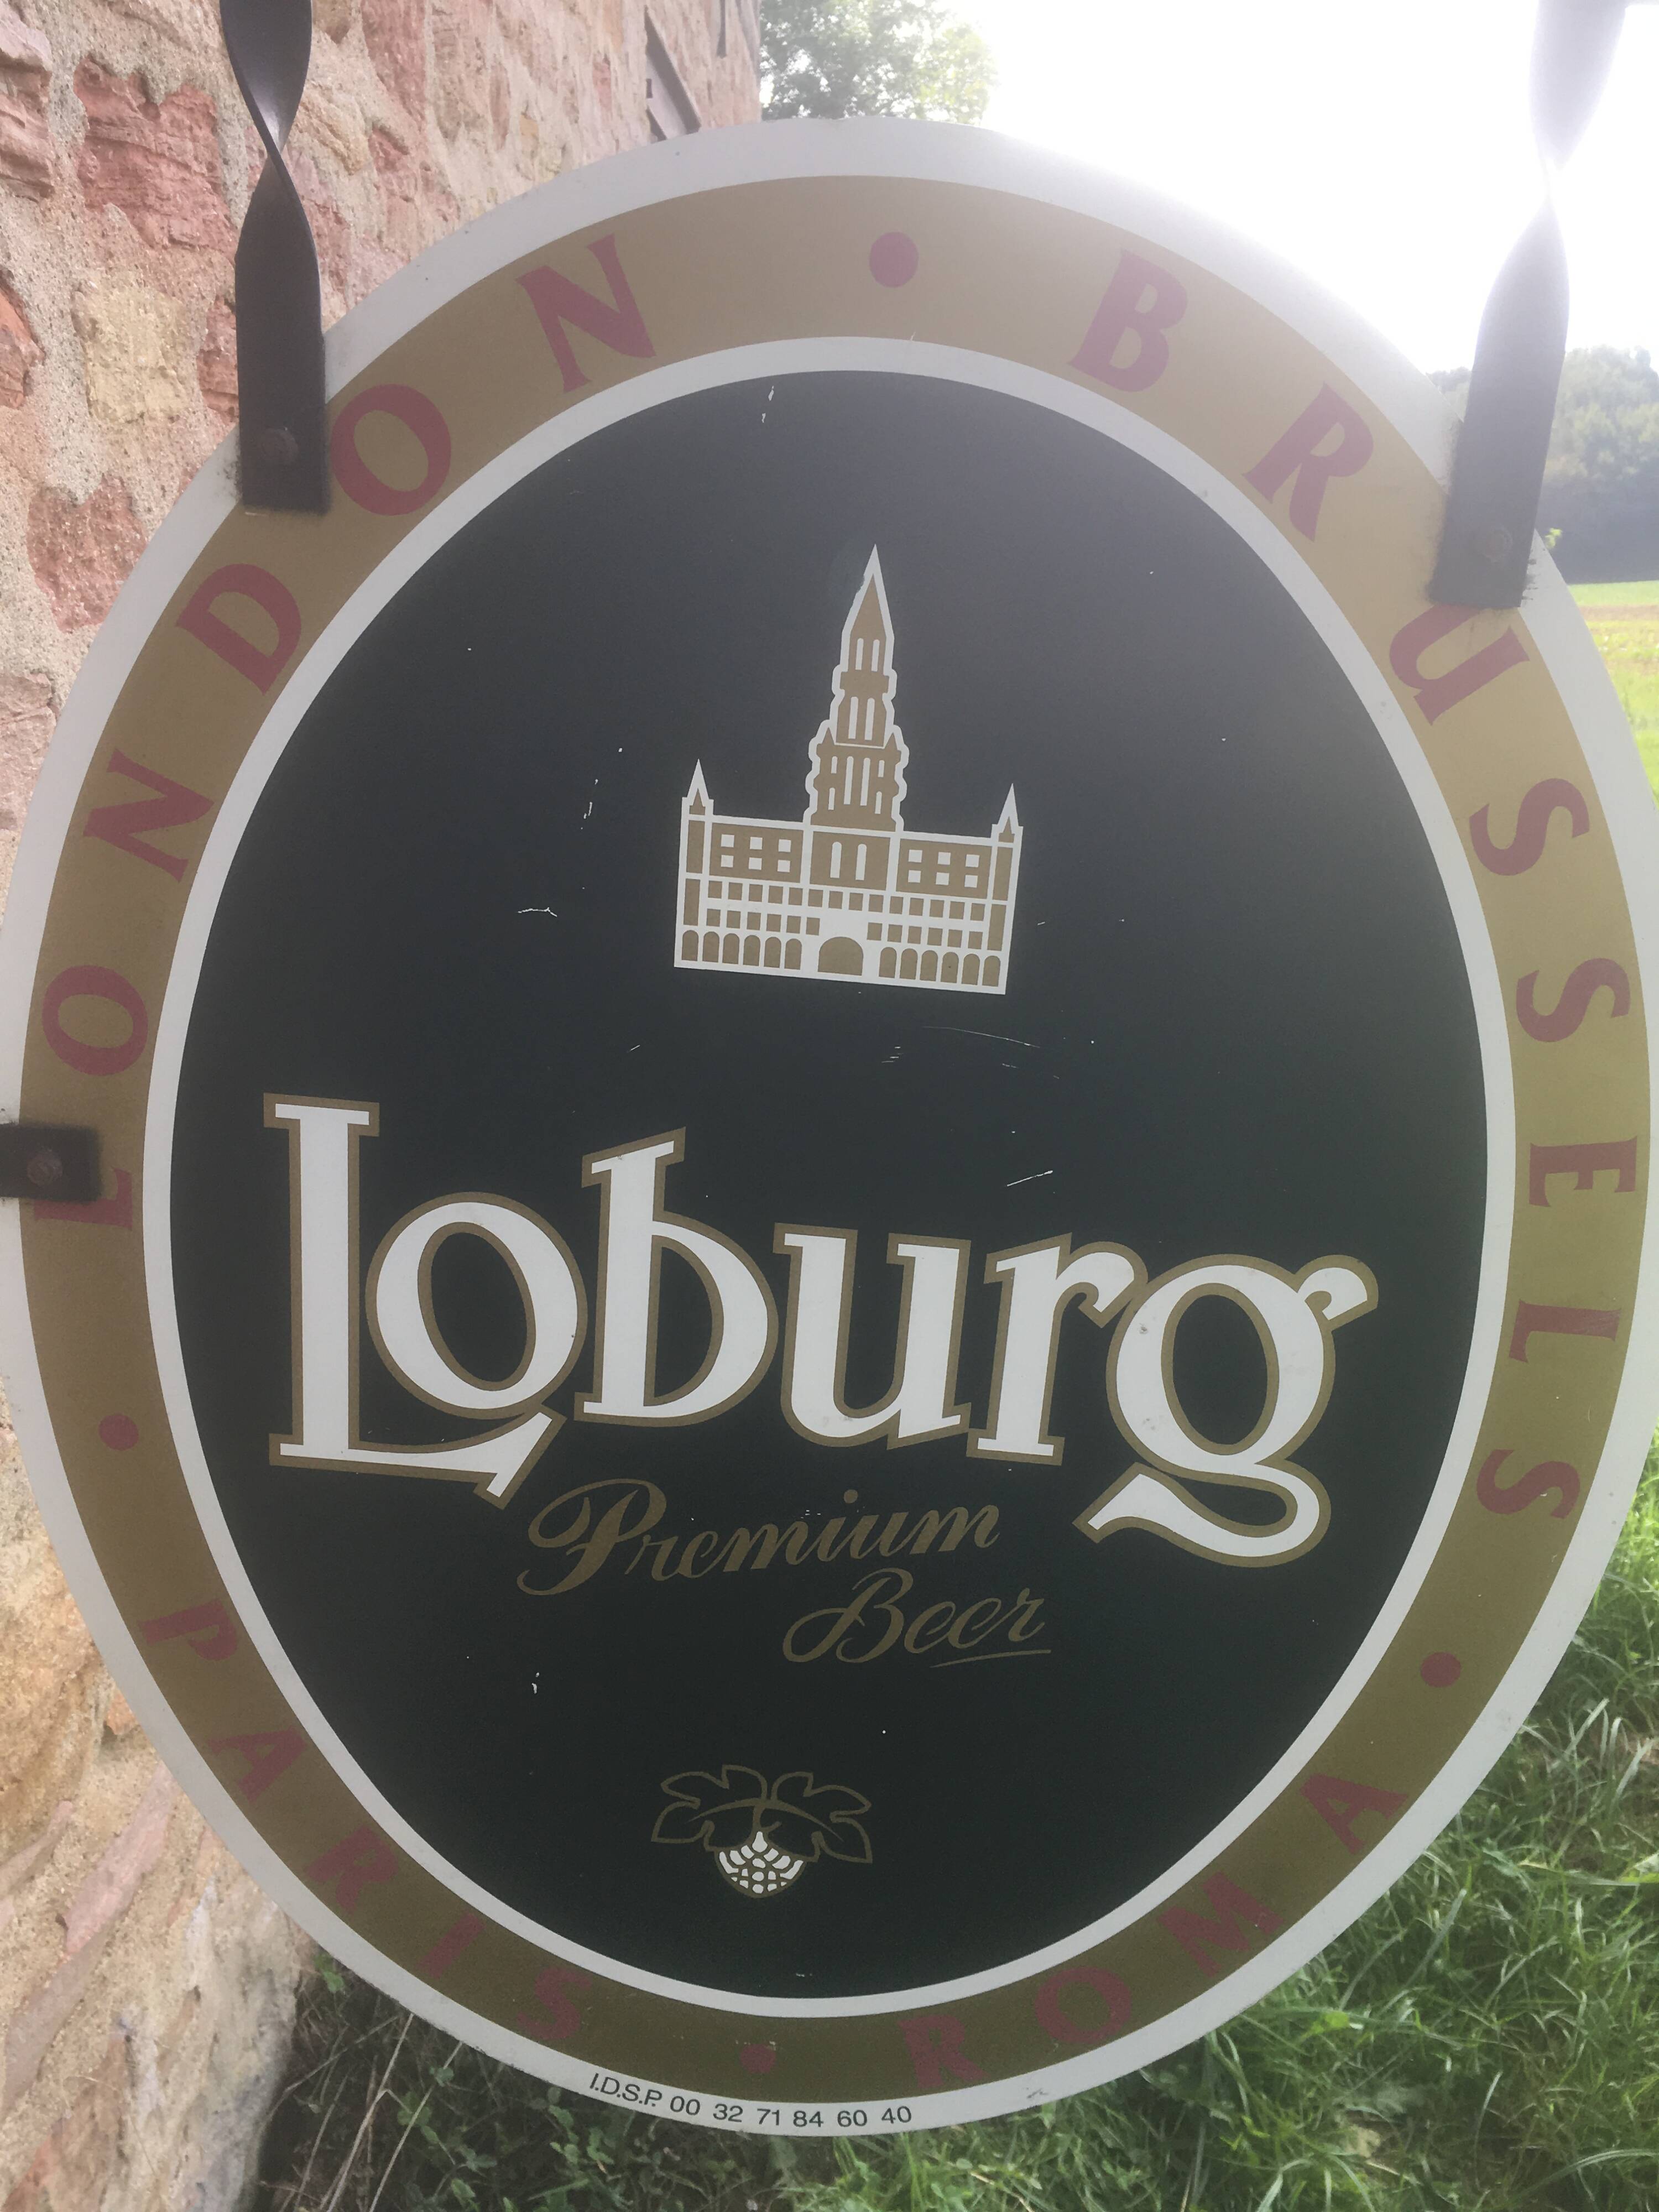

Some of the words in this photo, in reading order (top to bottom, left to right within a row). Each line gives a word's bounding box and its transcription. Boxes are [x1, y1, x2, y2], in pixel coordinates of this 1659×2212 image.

[33, 233, 655, 1231] LONDON
[1068, 248, 1638, 1522] BRUSSELS
[263, 1092, 1379, 1569] Loburg
[517, 1478, 1000, 1596] Premium
[782, 1568, 1046, 1663] Beer
[138, 1598, 591, 2039] PARIS
[897, 1773, 1408, 2089] ROMA
[670, 2095, 701, 2116] 00
[713, 2104, 744, 2122] 32
[757, 2108, 780, 2126] 71
[793, 2111, 824, 2127] 84
[837, 2110, 868, 2127] 60
[881, 2106, 912, 2124] 40
